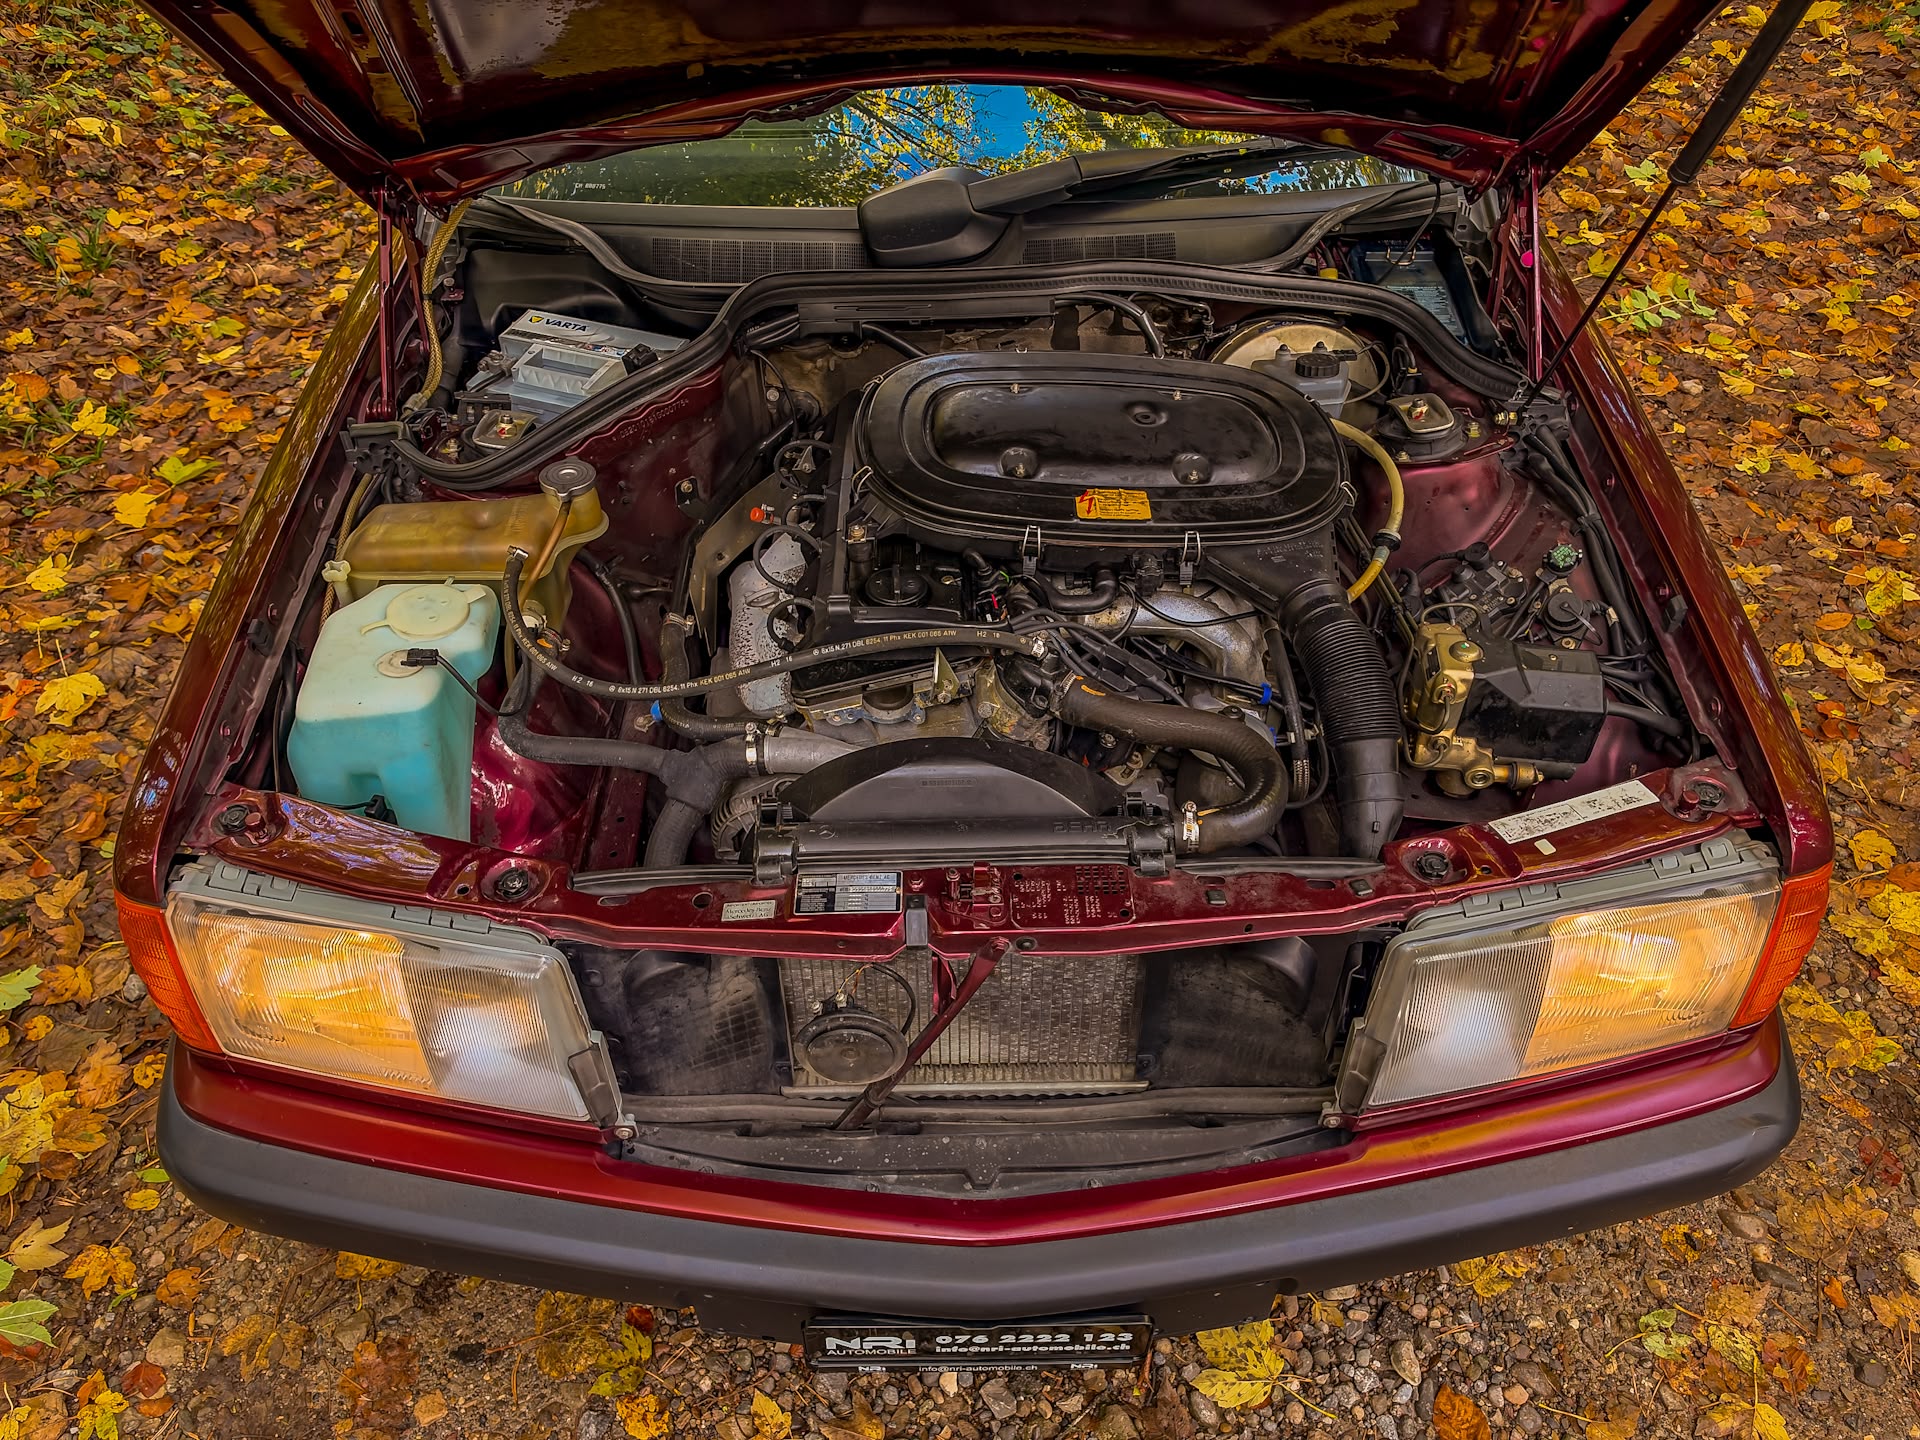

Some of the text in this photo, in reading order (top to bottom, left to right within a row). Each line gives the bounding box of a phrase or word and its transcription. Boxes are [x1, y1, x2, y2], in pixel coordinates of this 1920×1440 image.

[544, 318, 588, 332] VARTA
[903, 632, 916, 640] KEK
[918, 631, 929, 639] 001
[771, 655, 793, 668] H2 16
[572, 675, 584, 685] H2
[700, 678, 713, 686] KEK
[714, 675, 724, 683] 001
[825, 1336, 916, 1349] NRI
[935, 1332, 1134, 1344] 076 2222 123
[935, 1343, 1131, 1353] info@nri-automobile.ch
[918, 1364, 1038, 1373] info@nri-automobile.ch
